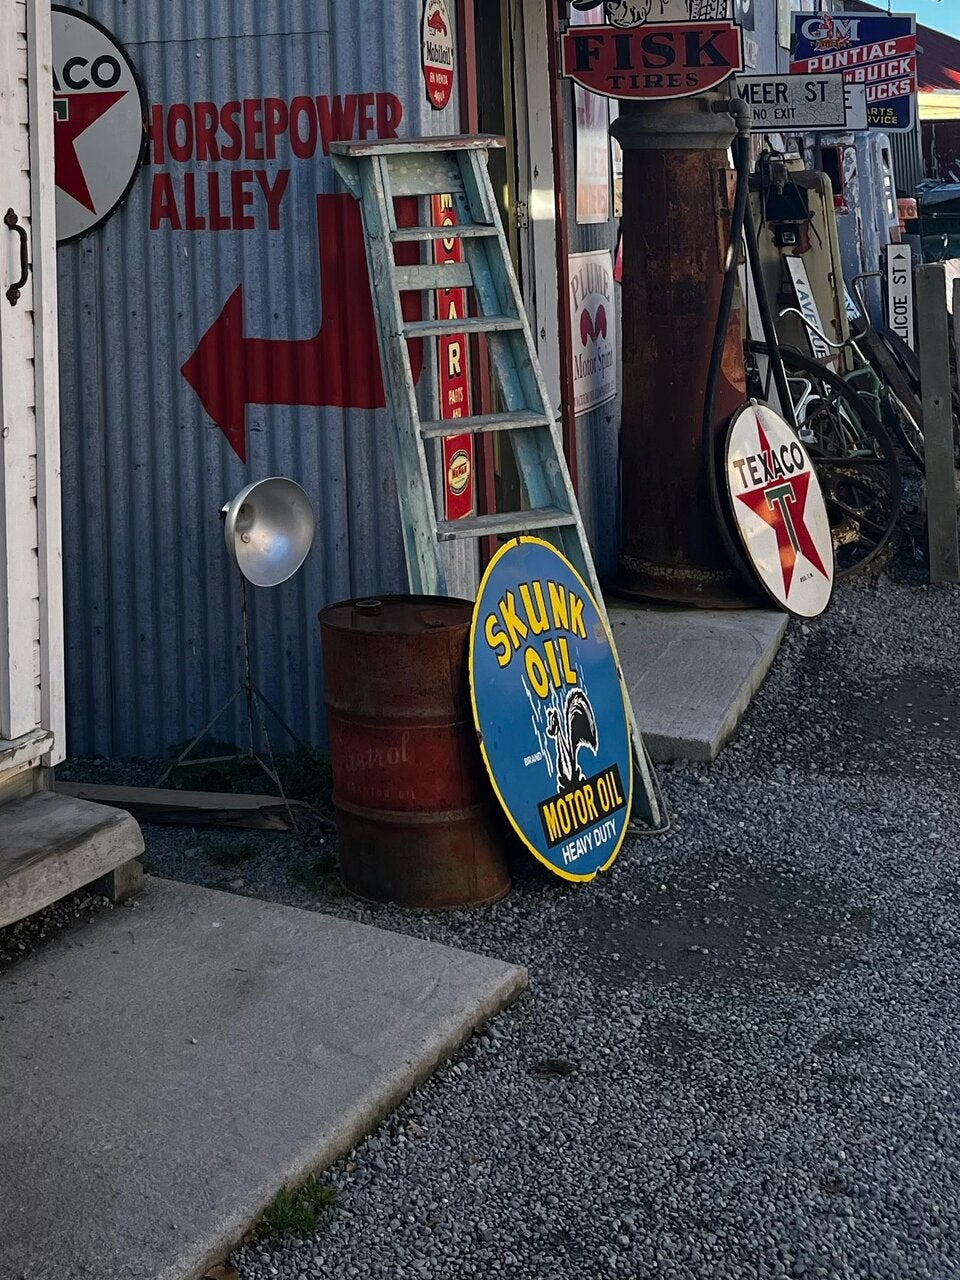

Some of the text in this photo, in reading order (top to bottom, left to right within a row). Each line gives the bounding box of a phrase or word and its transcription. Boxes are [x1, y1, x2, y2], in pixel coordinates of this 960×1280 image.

[801, 18, 862, 42] GM
[426, 40, 451, 66] Mobiloil
[571, 29, 731, 72] FISK
[807, 40, 898, 74] PONTIAC
[606, 72, 699, 90] TIRES
[855, 58, 911, 83] BUICK
[804, 80, 829, 103] ST
[144, 91, 404, 165] HORSEPOWER
[753, 107, 797, 120] NO EXIT
[149, 169, 291, 232] ALLEY
[570, 263, 611, 313] PLUME
[892, 266, 907, 286] ST
[574, 344, 613, 381] Motor Spirit
[448, 387, 464, 406] PARTS
[732, 441, 805, 489] TEXACO
[484, 580, 588, 668] SKUNK
[524, 637, 578, 700] OIL
[524, 751, 543, 767] BRAND
[542, 771, 624, 843] MOTOR OIL
[562, 818, 617, 865] HEAVY DUTY
